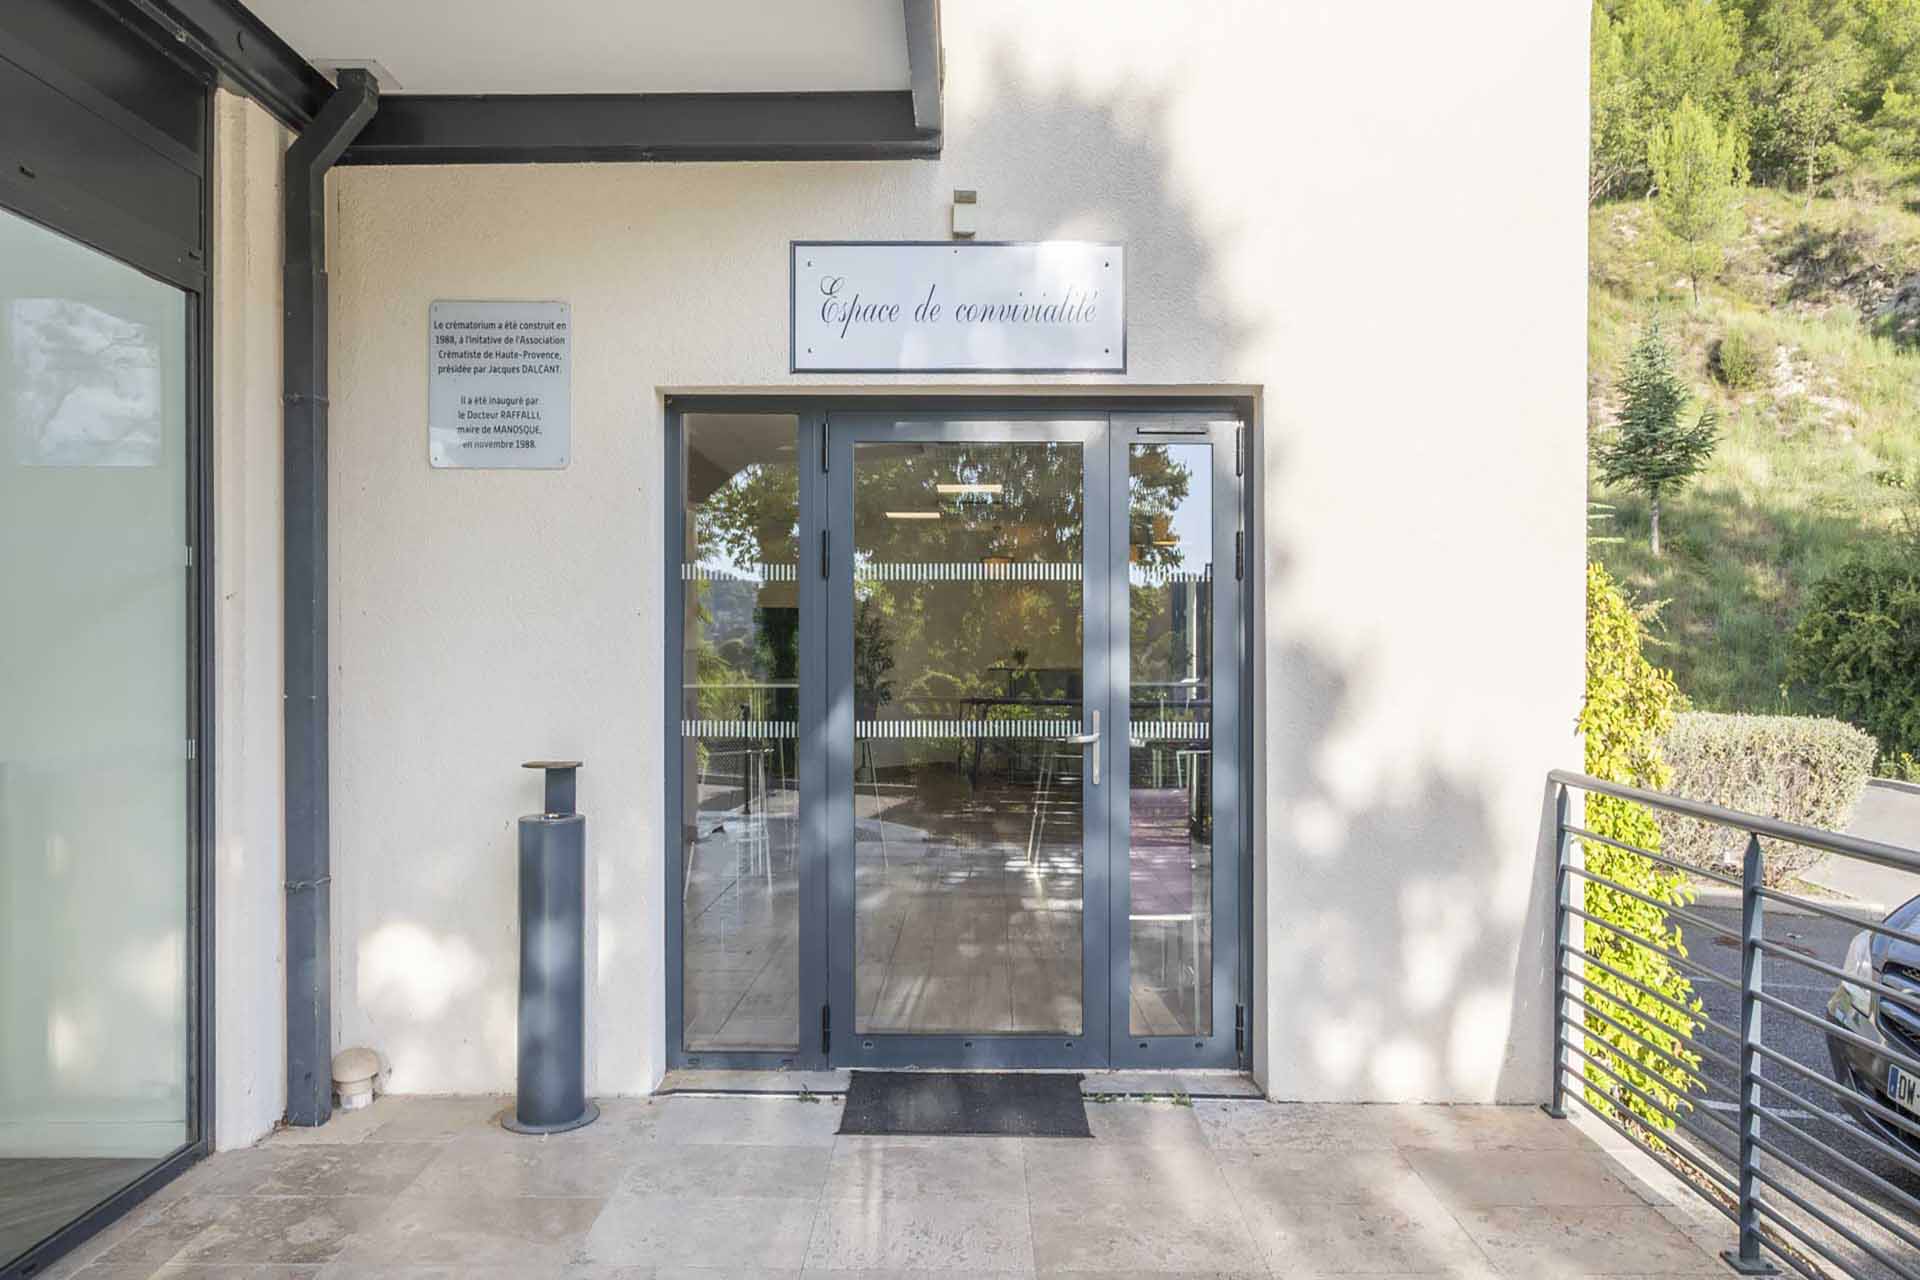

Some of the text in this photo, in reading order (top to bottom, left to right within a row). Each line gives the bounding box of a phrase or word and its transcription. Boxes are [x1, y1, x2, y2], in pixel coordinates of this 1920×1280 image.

[820, 275, 1099, 339] Espace de convivialité
[433, 320, 567, 331] Le crématorium a été construit en
[435, 335, 457, 346] 1988,
[458, 335, 464, 345] à
[504, 335, 514, 345] de
[515, 335, 565, 345] l'Association
[438, 350, 562, 361] Crématiste de Haute-Provence,
[438, 364, 471, 376] présidée
[473, 366, 487, 376] par
[488, 364, 520, 376] Jacques
[474, 395, 487, 405] été
[525, 397, 539, 407] par
[457, 410, 465, 420] le
[467, 410, 498, 420] Docteur
[457, 424, 480, 434] maire
[481, 424, 492, 434] de
[462, 441, 473, 449] en
[474, 439, 514, 449] novembre
